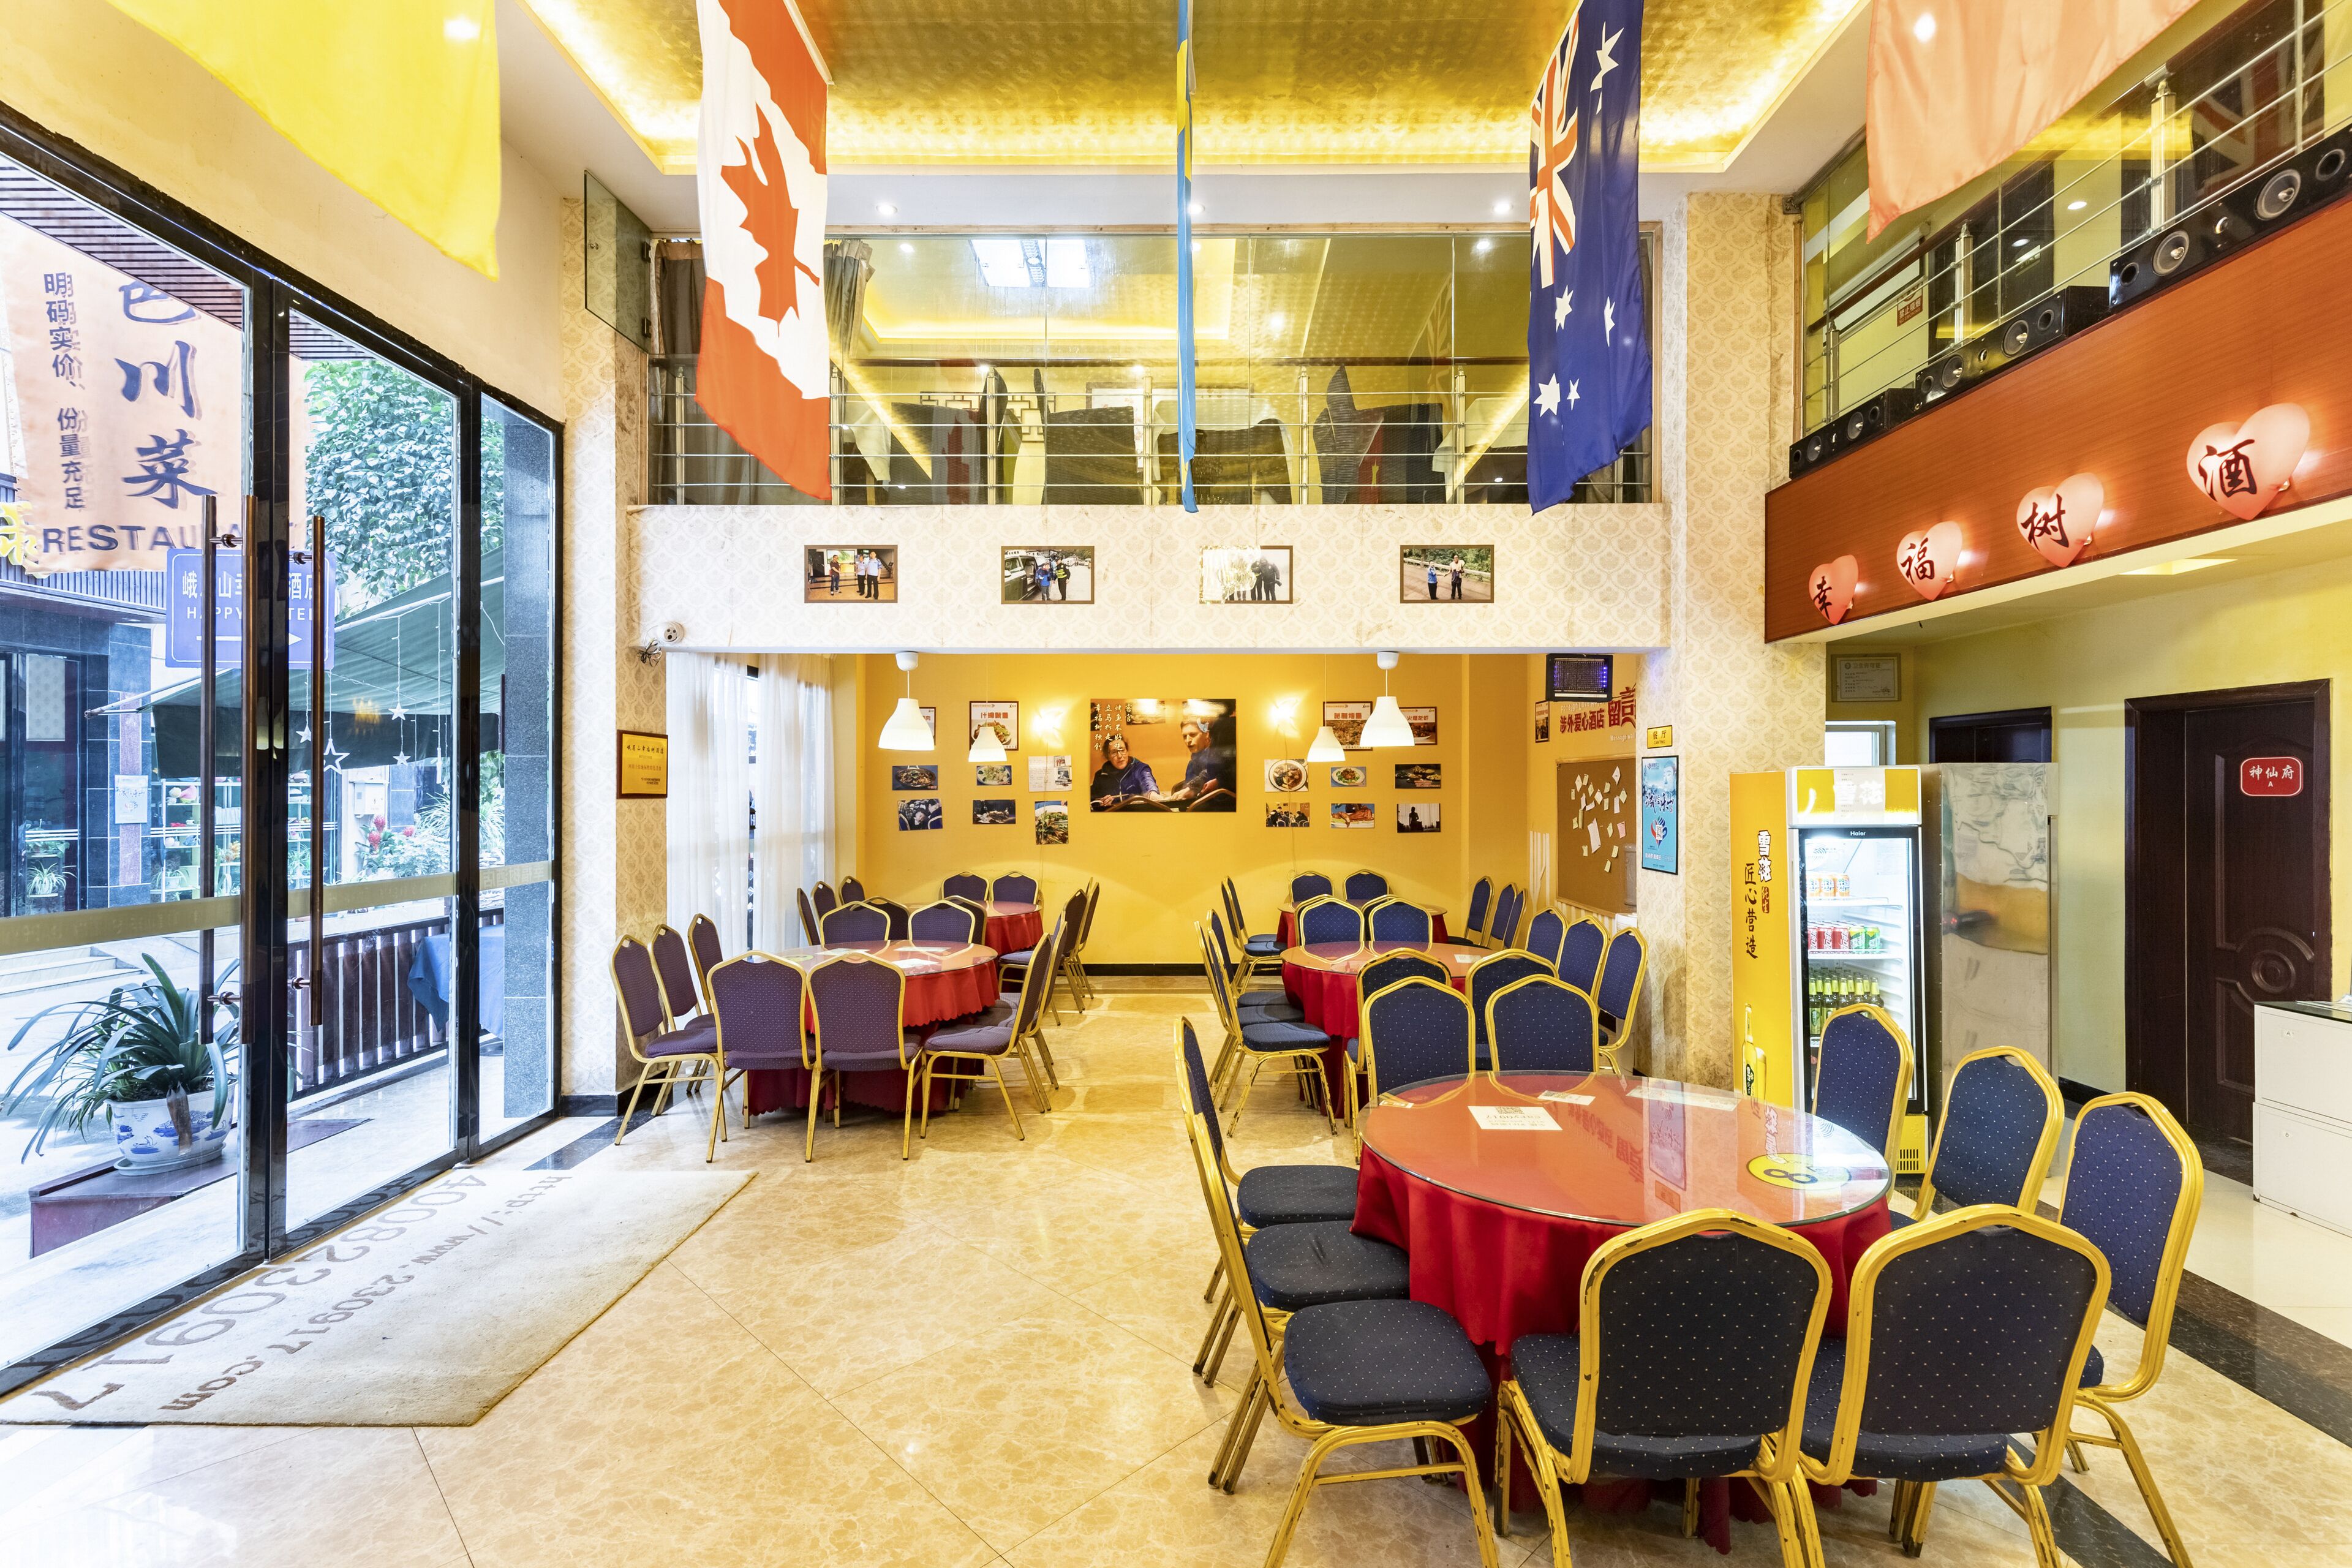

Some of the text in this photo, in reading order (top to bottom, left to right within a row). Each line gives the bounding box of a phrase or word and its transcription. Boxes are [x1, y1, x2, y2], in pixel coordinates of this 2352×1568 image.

[1094, 704, 1102, 751] 幸福树独创
[1560, 708, 1605, 734] 涉外爱心酒店
[2249, 764, 2294, 781] 神仙府
[1758, 830, 1772, 882] 雪花
[1745, 862, 1758, 959] 匠心营造
[1762, 887, 1770, 913] 纯生
[29, 1172, 488, 1412] 4008230917
